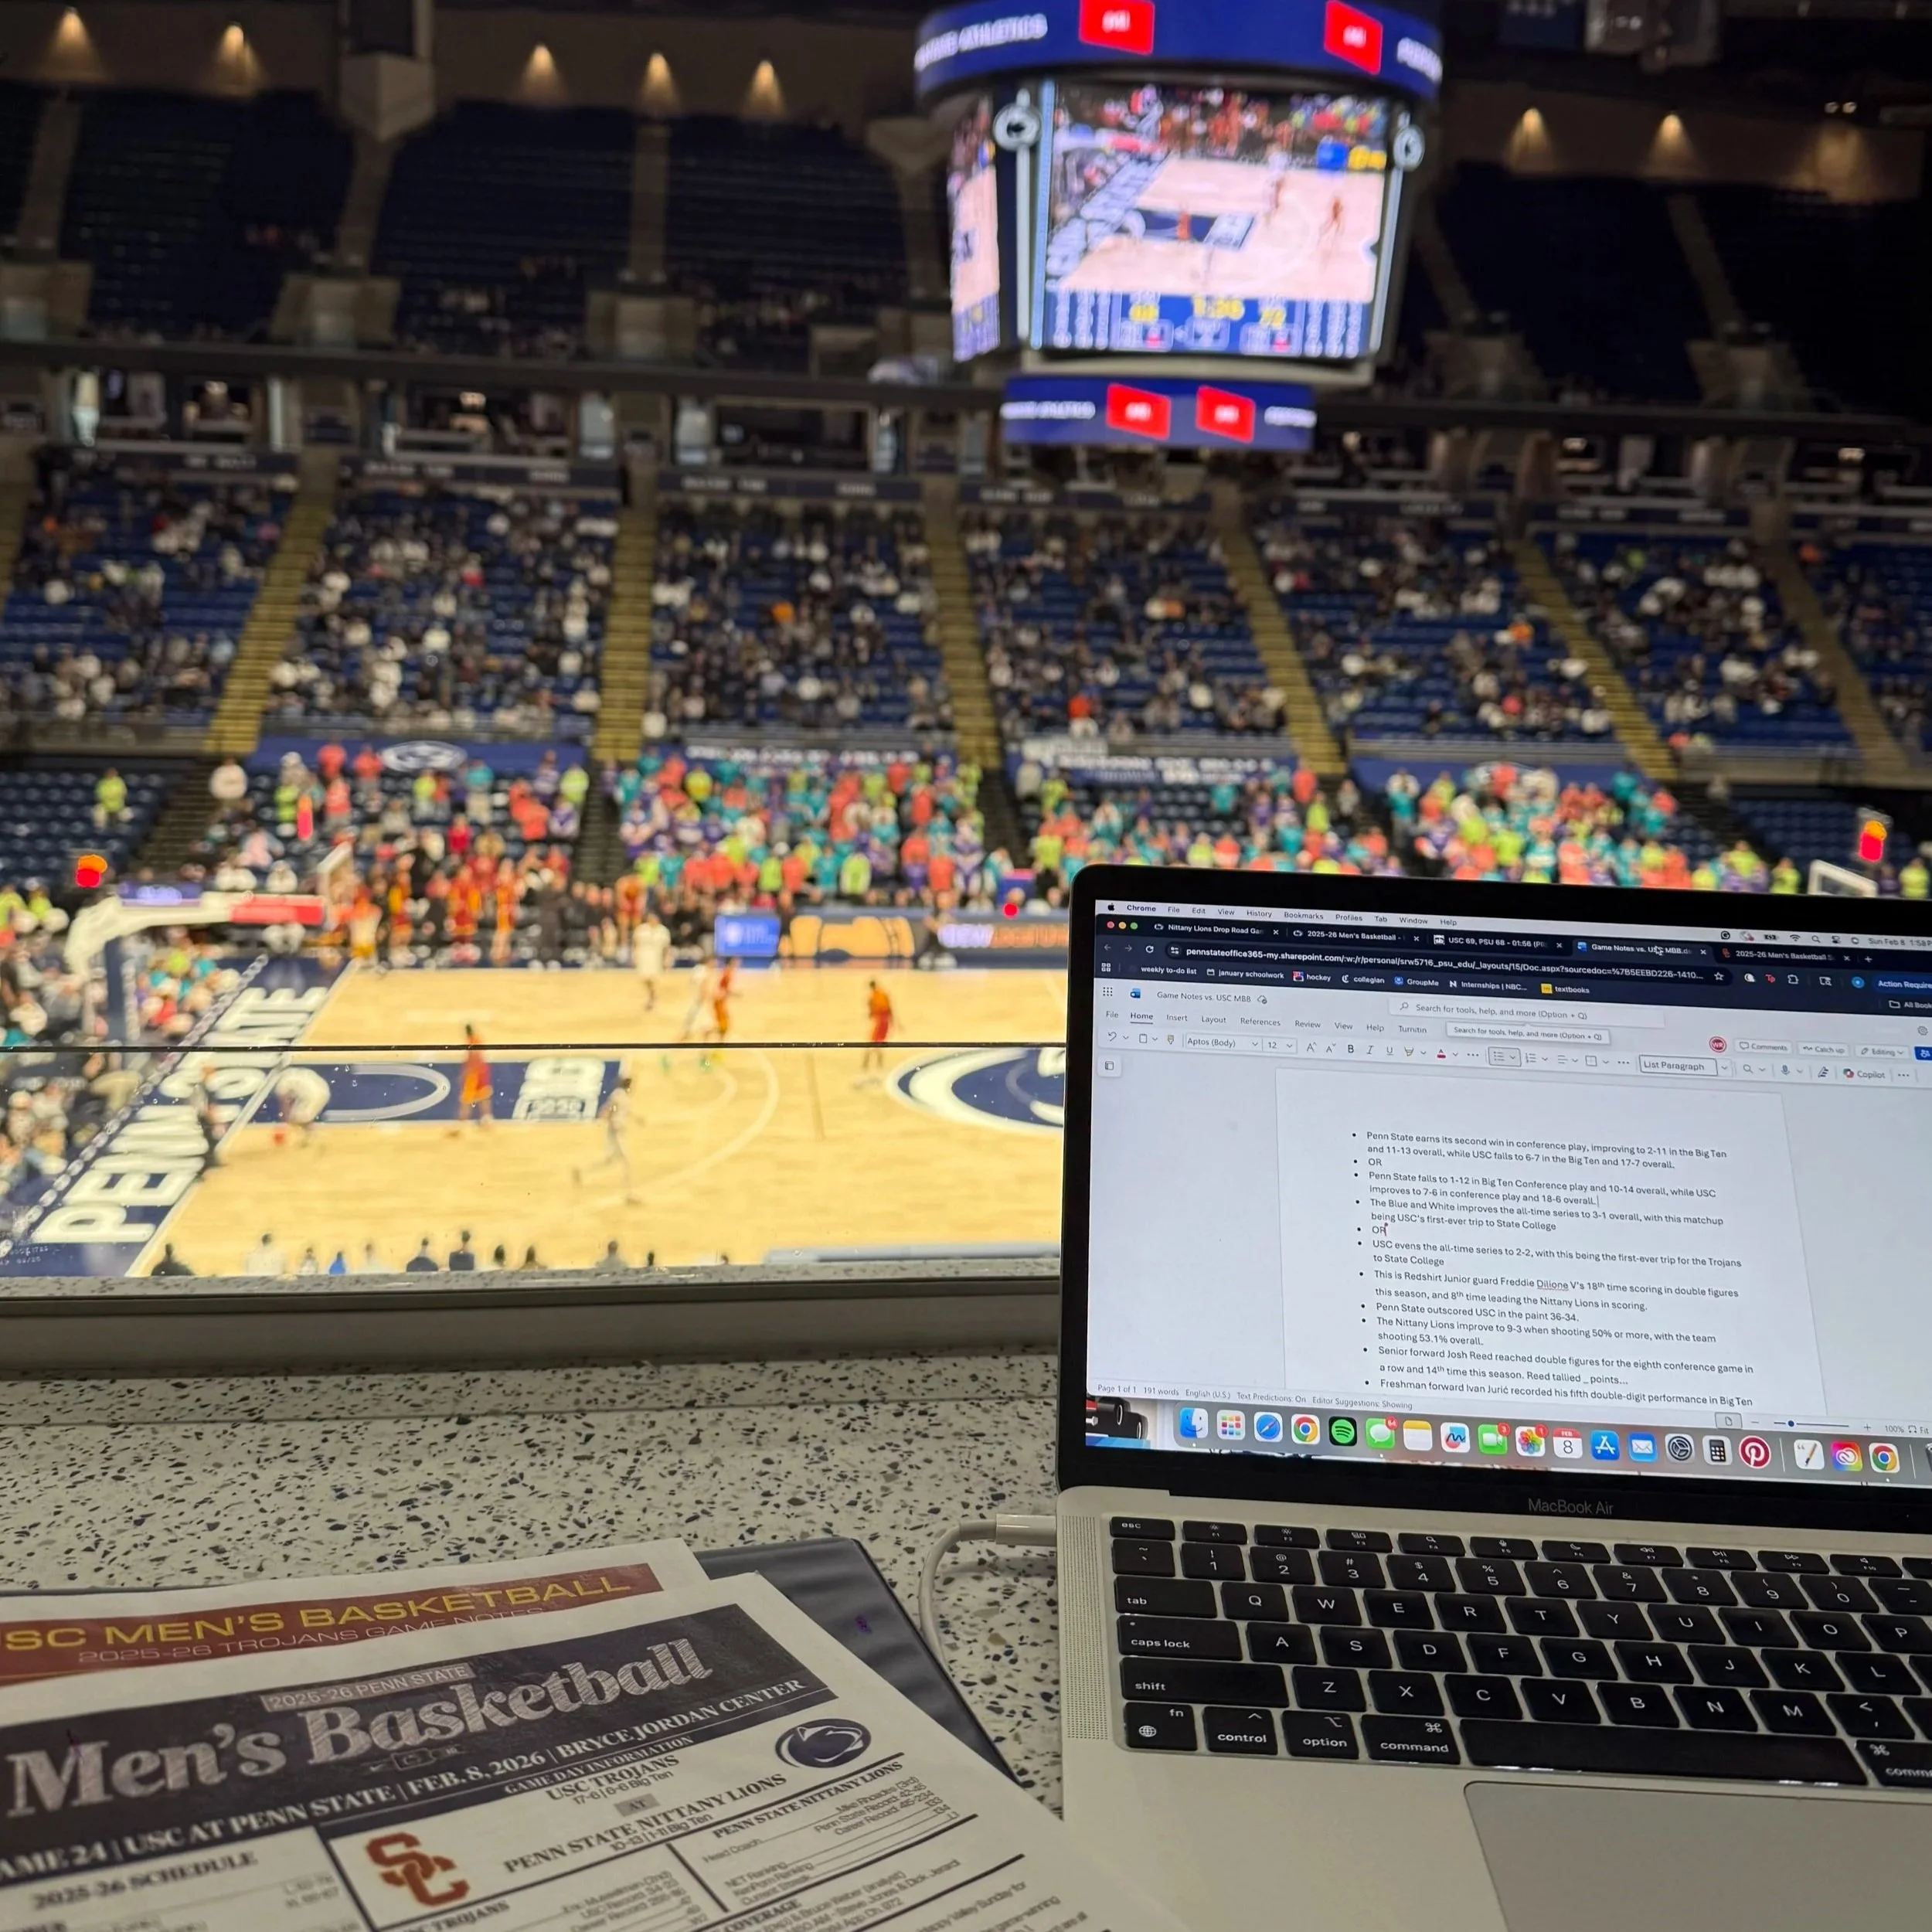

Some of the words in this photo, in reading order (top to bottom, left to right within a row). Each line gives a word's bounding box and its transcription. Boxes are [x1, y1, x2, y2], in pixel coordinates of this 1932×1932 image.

[1247, 910, 1272, 918] History
[1284, 911, 1324, 920] Bookmarks
[1219, 969, 1244, 978] january
[1307, 974, 1331, 982] hockey
[1130, 1012, 1153, 1020] Home
[1202, 1015, 1226, 1025] Layout
[1240, 1017, 1281, 1026] References
[1366, 1024, 1384, 1032] Help
[1188, 1038, 1209, 1046] Aptos
[1211, 1039, 1236, 1049] (Body)
[1644, 1060, 1659, 1069] List
[1661, 1061, 1705, 1071] Paragraph
[1857, 1070, 1886, 1080] Copilot
[1367, 1131, 1389, 1140] Penn
[1390, 1132, 1413, 1141] State
[1488, 1138, 1504, 1147] win
[1516, 1141, 1566, 1150] conference
[1568, 1143, 1590, 1153] play,
[1591, 1144, 1635, 1155] improving
[1647, 1147, 1666, 1155] 2-11
[1695, 1148, 1709, 1158] Big
[1368, 1158, 1383, 1166] OR
[1371, 1212, 1396, 1222] being
[1397, 1213, 1425, 1223] USC's
[1427, 1215, 1466, 1225] first-ever
[1468, 1218, 1484, 1227] trip
[1497, 1219, 1520, 1228] State
[1522, 1220, 1556, 1232] College
[1376, 1302, 1400, 1311] Penn
[1401, 1304, 1425, 1313] State
[1427, 1307, 1473, 1316] outscored
[1475, 1308, 1495, 1317] USC
[1498, 1309, 1506, 1318] in
[1508, 1310, 1523, 1318] the
[1525, 1311, 1549, 1321] paint
[1550, 1312, 1579, 1321] 36-34.
[1378, 1332, 1417, 1344] shooting
[1419, 1334, 1448, 1344] 53.1%
[1450, 1337, 1484, 1345] overall.
[1379, 1345, 1408, 1355] Senior
[1410, 1348, 1445, 1358] forward
[1447, 1350, 1468, 1359] Josh
[1469, 1351, 1493, 1360] Reed
[1495, 1354, 1532, 1362] reached
[1535, 1355, 1566, 1365] double
[1569, 1356, 1600, 1367] figures
[1601, 1358, 1614, 1367] for
[1616, 1359, 1631, 1368] the
[1633, 1359, 1662, 1370] eighth
[1664, 1362, 1716, 1372] conference
[1717, 1366, 1743, 1374] game
[1745, 1365, 1753, 1373] in
[1528, 1498, 1593, 1515] MacBook
[1595, 1501, 1614, 1515] Air
[105, 1612, 284, 1645] MEN'S
[300, 1577, 631, 1628] BASKETBALL
[79, 1645, 213, 1663] 2025-26
[218, 1631, 359, 1651] TROJANS
[366, 1619, 446, 1637] GAME
[1131, 1639, 1161, 1648] caps
[1164, 1639, 1190, 1648] lock
[272, 1687, 352, 1709] 2025-26
[356, 1678, 407, 1696] PENN
[411, 1666, 468, 1685] STATE
[1134, 1682, 1165, 1691] shift
[1169, 1709, 1184, 1717] fn
[6, 1723, 286, 1817] Men's
[299, 1638, 713, 1764] Basketball
[1217, 1733, 1267, 1743] control
[1303, 1737, 1347, 1747] option
[1380, 1743, 1449, 1753] command
[505, 1774, 554, 1794] GAME
[553, 1764, 586, 1781] DAY
[586, 1736, 694, 1773] INFORMATION
[0, 1845, 68, 1880] AME
[76, 1841, 107, 1864] 24
[124, 1828, 185, 1855] USC
[189, 1818, 224, 1841] AT
[230, 1803, 308, 1835] PENN
[309, 1787, 394, 1817] STATE
[406, 1771, 466, 1797] FEB.
[466, 1766, 491, 1781] 8,
[488, 1750, 546, 1776] 2026
[556, 1728, 635, 1758] BRYCE
[632, 1705, 722, 1741] JORDAN
[719, 1679, 808, 1712] CENTER
[546, 1782, 589, 1801] USC
[590, 1755, 679, 1787] TROJANS
[713, 1821, 757, 1839] PENN
[757, 1801, 803, 1824] STATE
[801, 1779, 863, 1808] NITTANY
[861, 1762, 903, 1782] LIONS
[503, 1846, 567, 1873] PENN
[567, 1822, 640, 1852] STATE
[637, 1794, 725, 1831] NITTANY
[726, 1774, 787, 1801] LIONS
